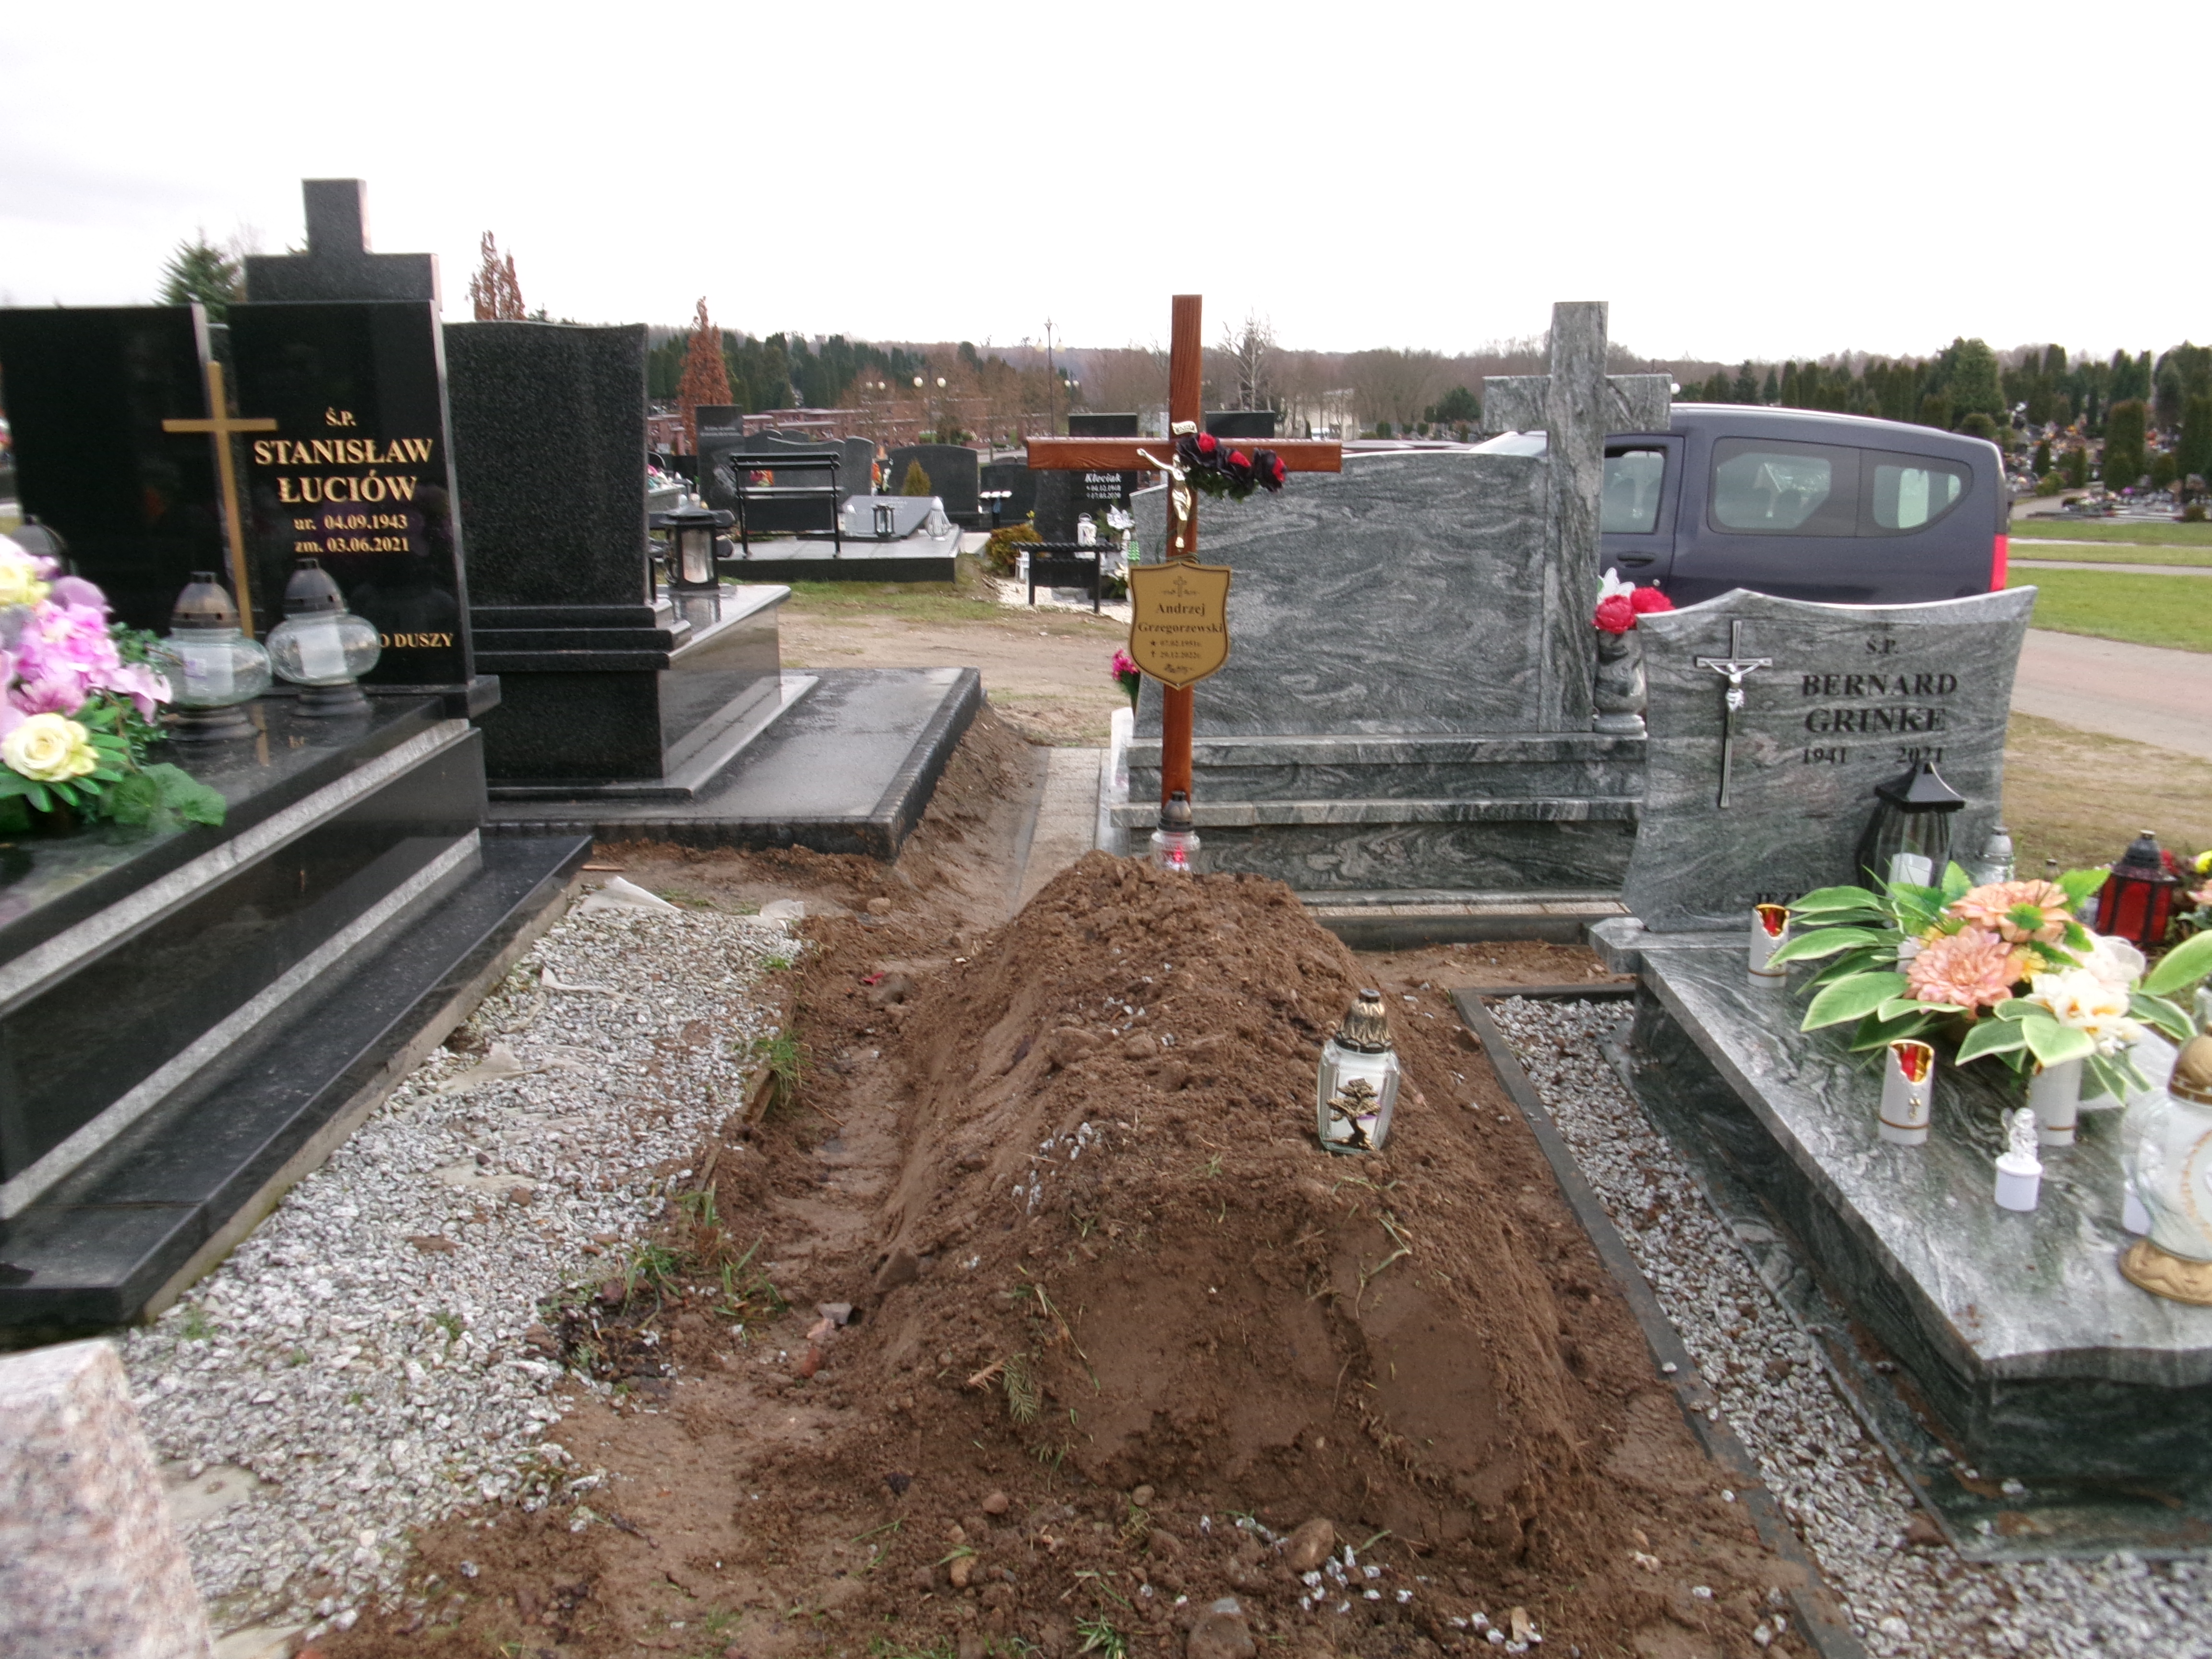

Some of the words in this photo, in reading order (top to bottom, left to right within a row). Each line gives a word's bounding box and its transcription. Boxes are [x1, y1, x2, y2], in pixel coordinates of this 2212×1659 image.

[325, 407, 357, 426] Ś.P.
[253, 438, 433, 465] STANISŁAW
[277, 469, 417, 503] ŁUCIÓW
[293, 517, 316, 530] ur.
[324, 514, 408, 529] 04.09.1943
[294, 541, 324, 553] zm.
[327, 537, 409, 553] 03.06.2021
[1157, 603, 1205, 616] Andrzej
[1138, 622, 1223, 635] Grzegorzewski
[393, 632, 454, 648] DUSZY
[1802, 673, 1958, 697] BERNARD
[1805, 708, 1947, 733] GRINKE
[1803, 747, 1847, 764] 1941
